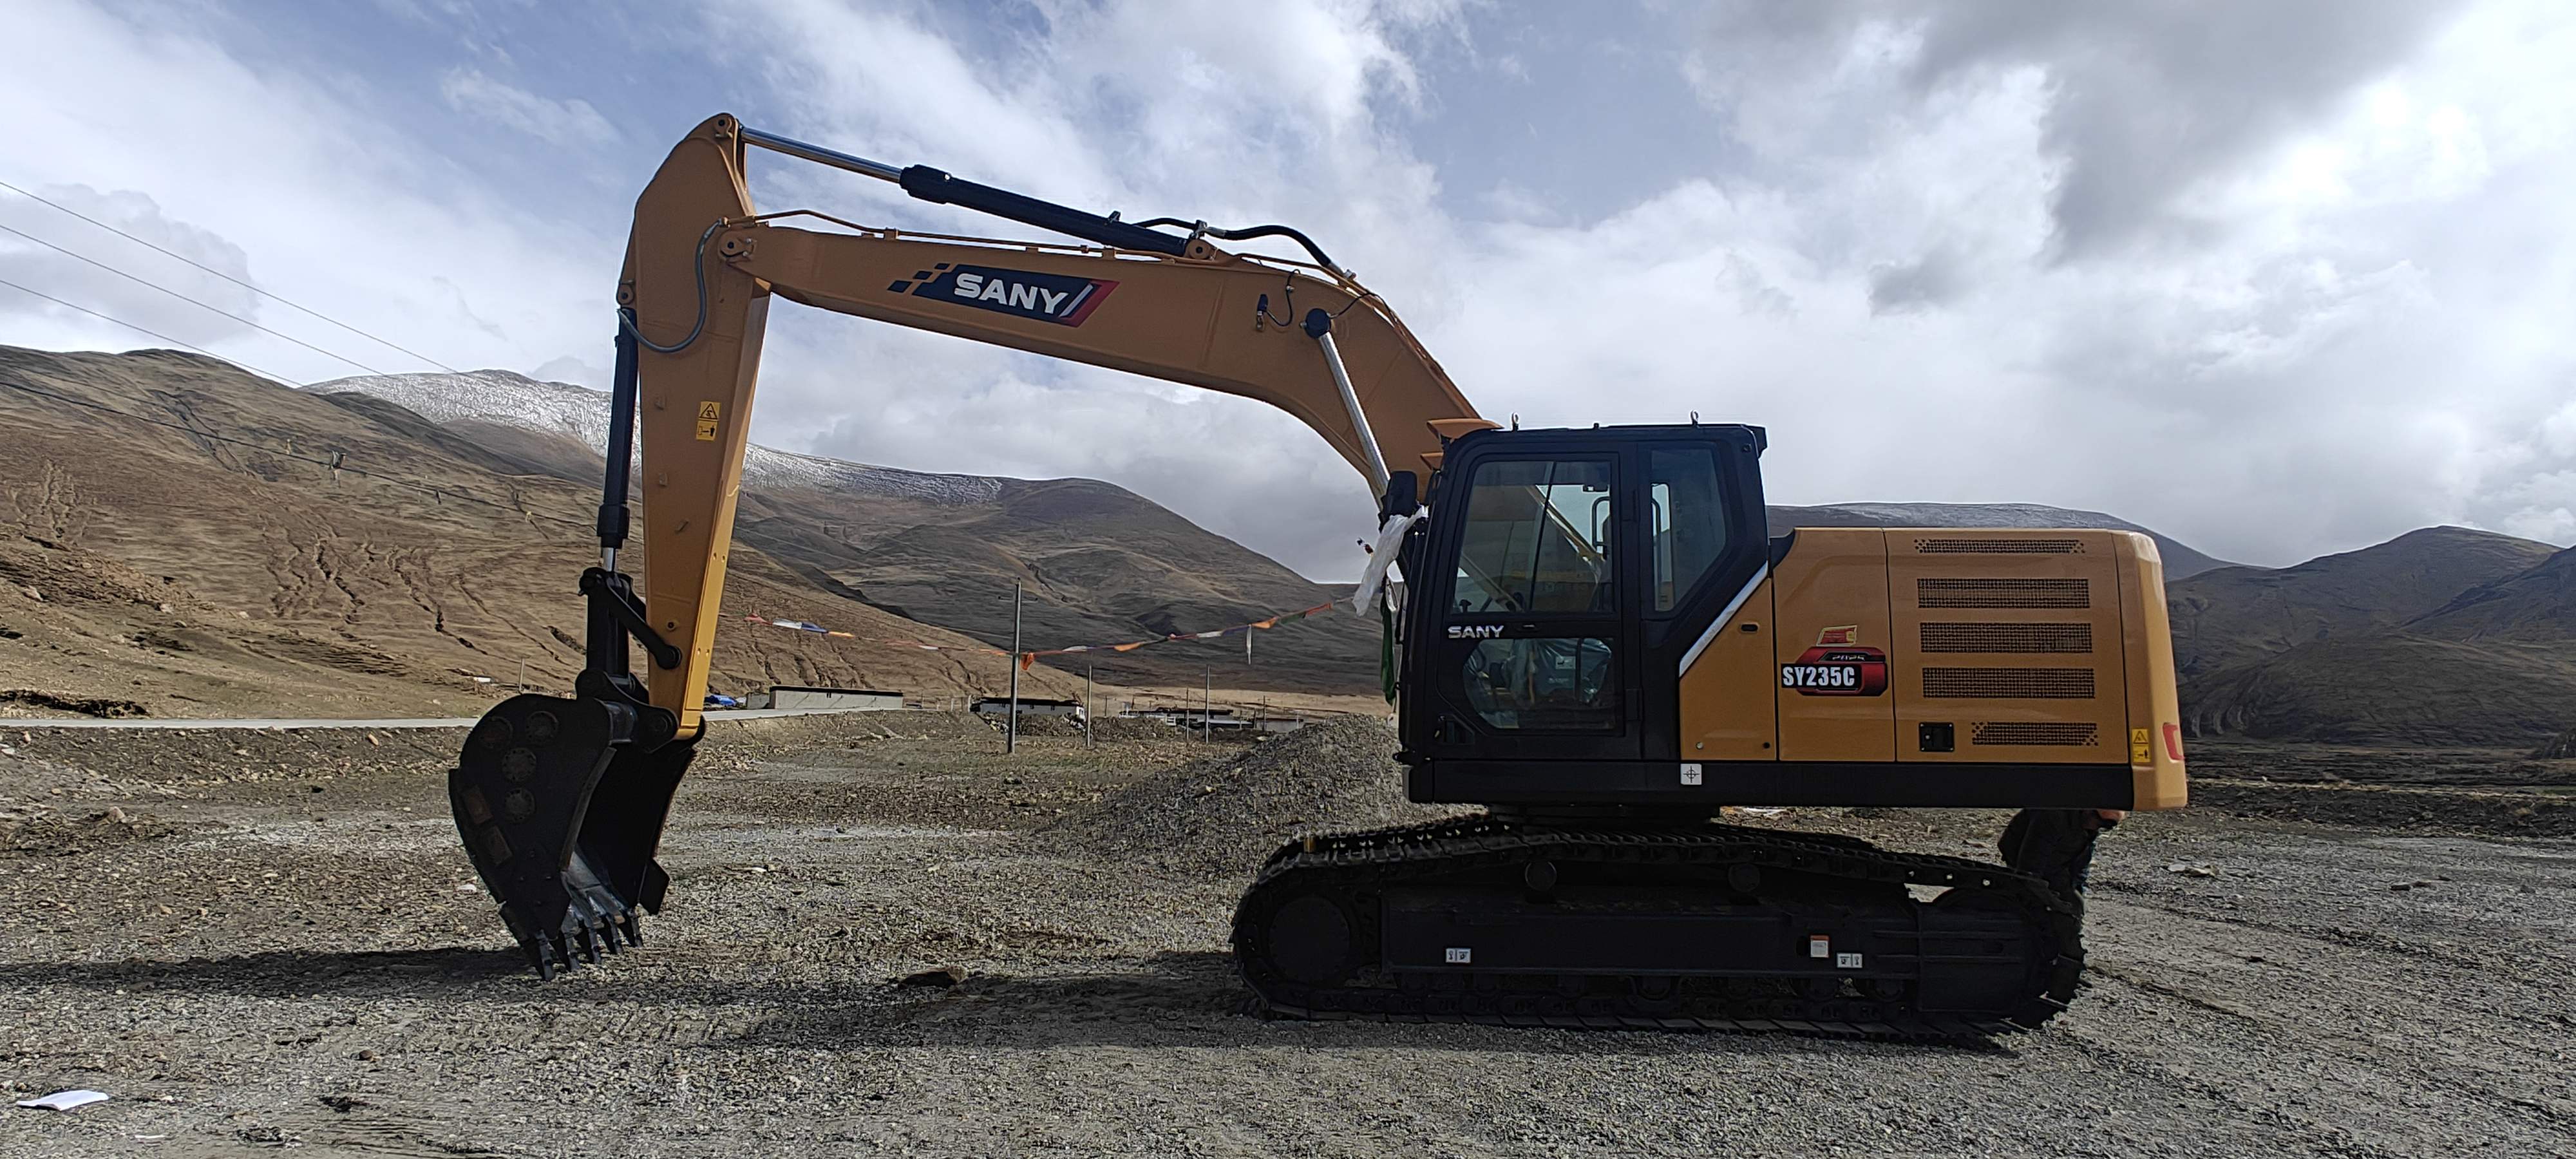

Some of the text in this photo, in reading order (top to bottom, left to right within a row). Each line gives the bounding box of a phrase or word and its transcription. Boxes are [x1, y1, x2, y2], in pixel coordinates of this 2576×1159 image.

[954, 273, 1068, 314] SANY
[1447, 625, 1504, 639] SANY
[1782, 666, 1855, 686] SY235C
